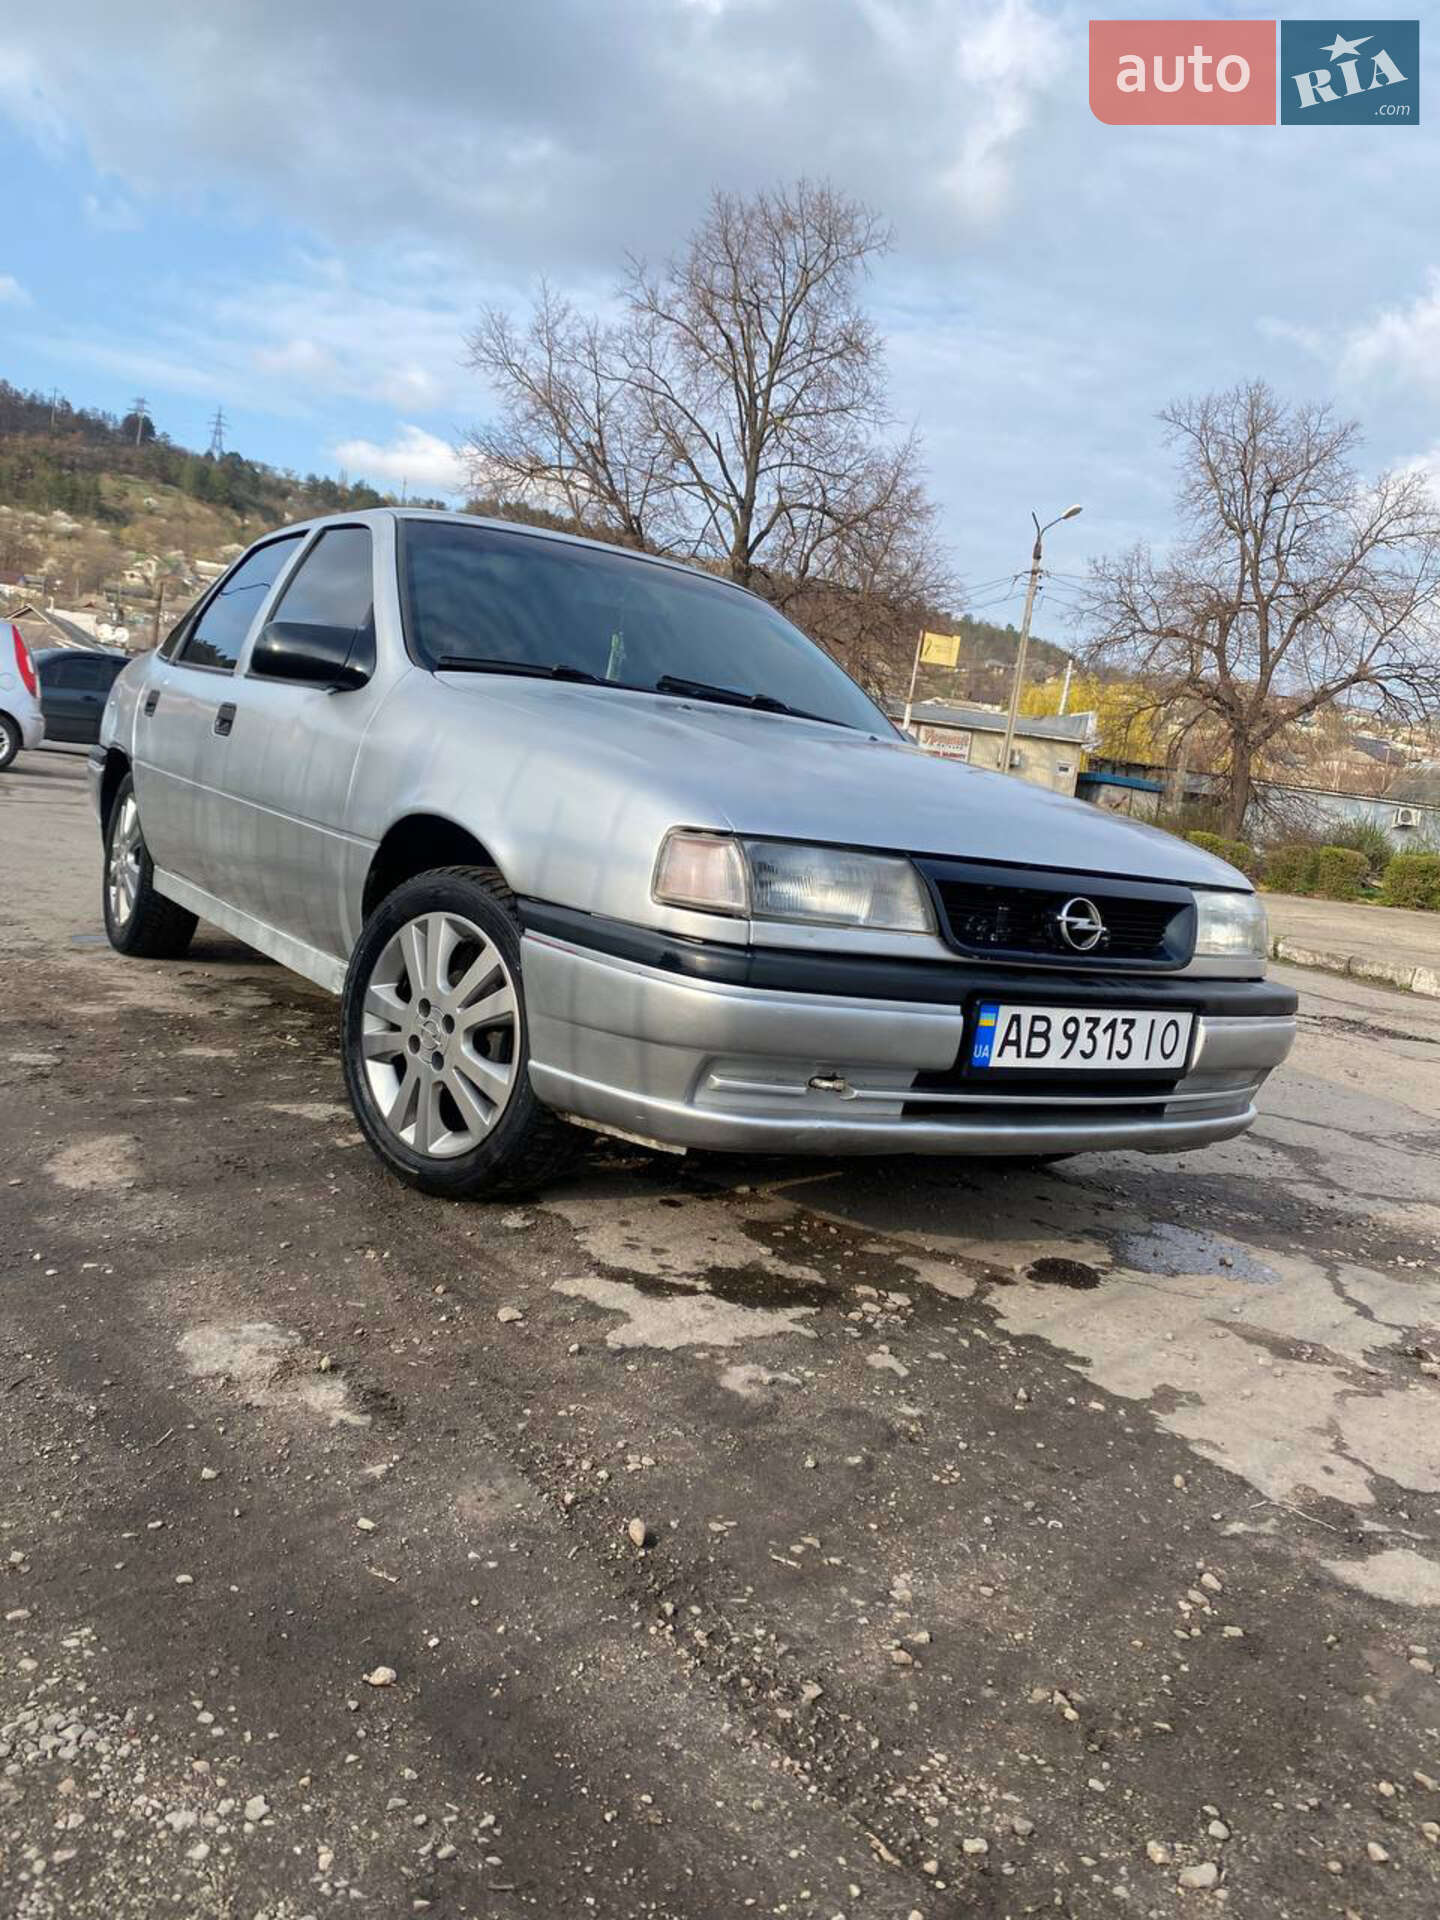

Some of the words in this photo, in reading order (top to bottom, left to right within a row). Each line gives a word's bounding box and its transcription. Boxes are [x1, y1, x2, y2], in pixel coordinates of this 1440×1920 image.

[973, 1044, 990, 1058] UA
[997, 1014, 1052, 1059] AB
[1060, 1016, 1136, 1060] 9313
